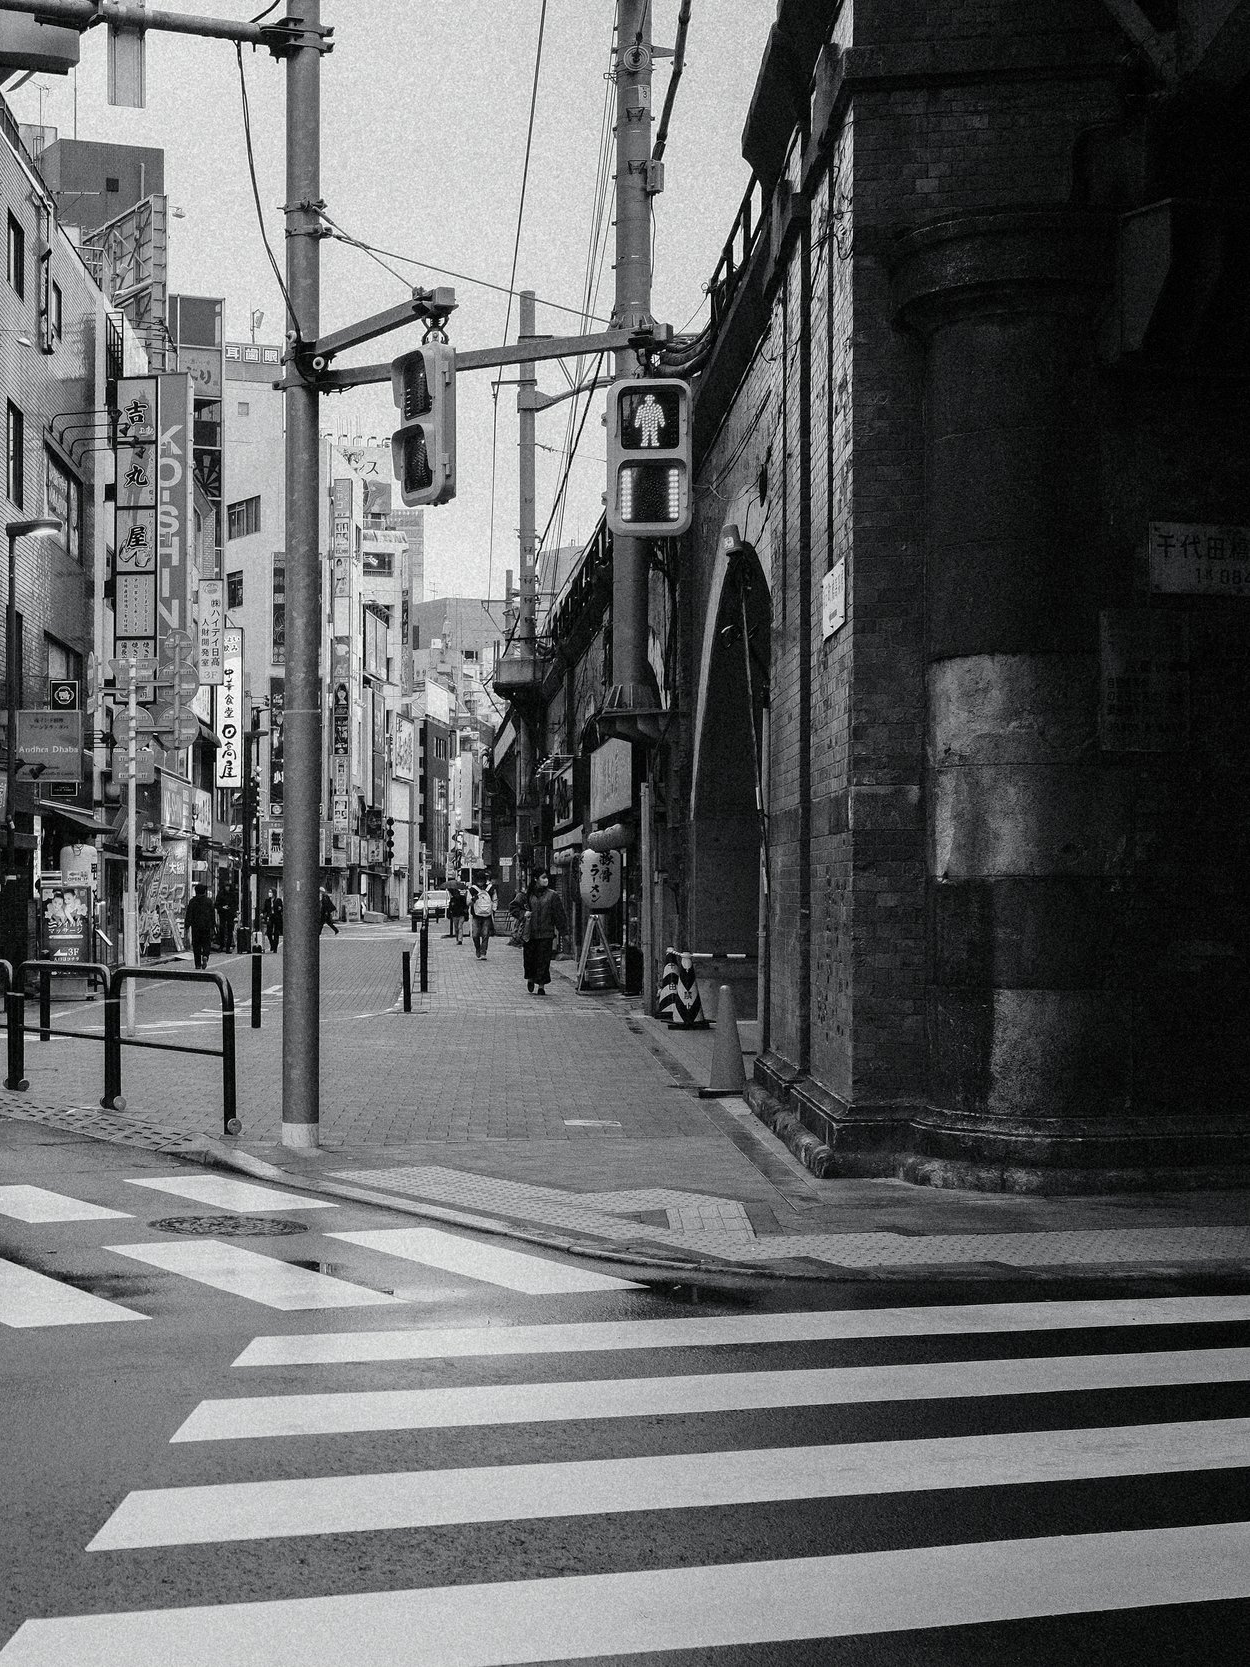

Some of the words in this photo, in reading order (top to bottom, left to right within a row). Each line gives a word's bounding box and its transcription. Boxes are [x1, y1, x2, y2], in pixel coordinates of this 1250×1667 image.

[124, 400, 149, 549] 吉丸屋
[201, 618, 210, 667] 人財開発室
[204, 671, 217, 679] 3F
[18, 745, 49, 753] Andhra
[52, 745, 79, 753] Dhaba
[589, 863, 600, 903] ラーメン
[68, 947, 80, 956] 3F
